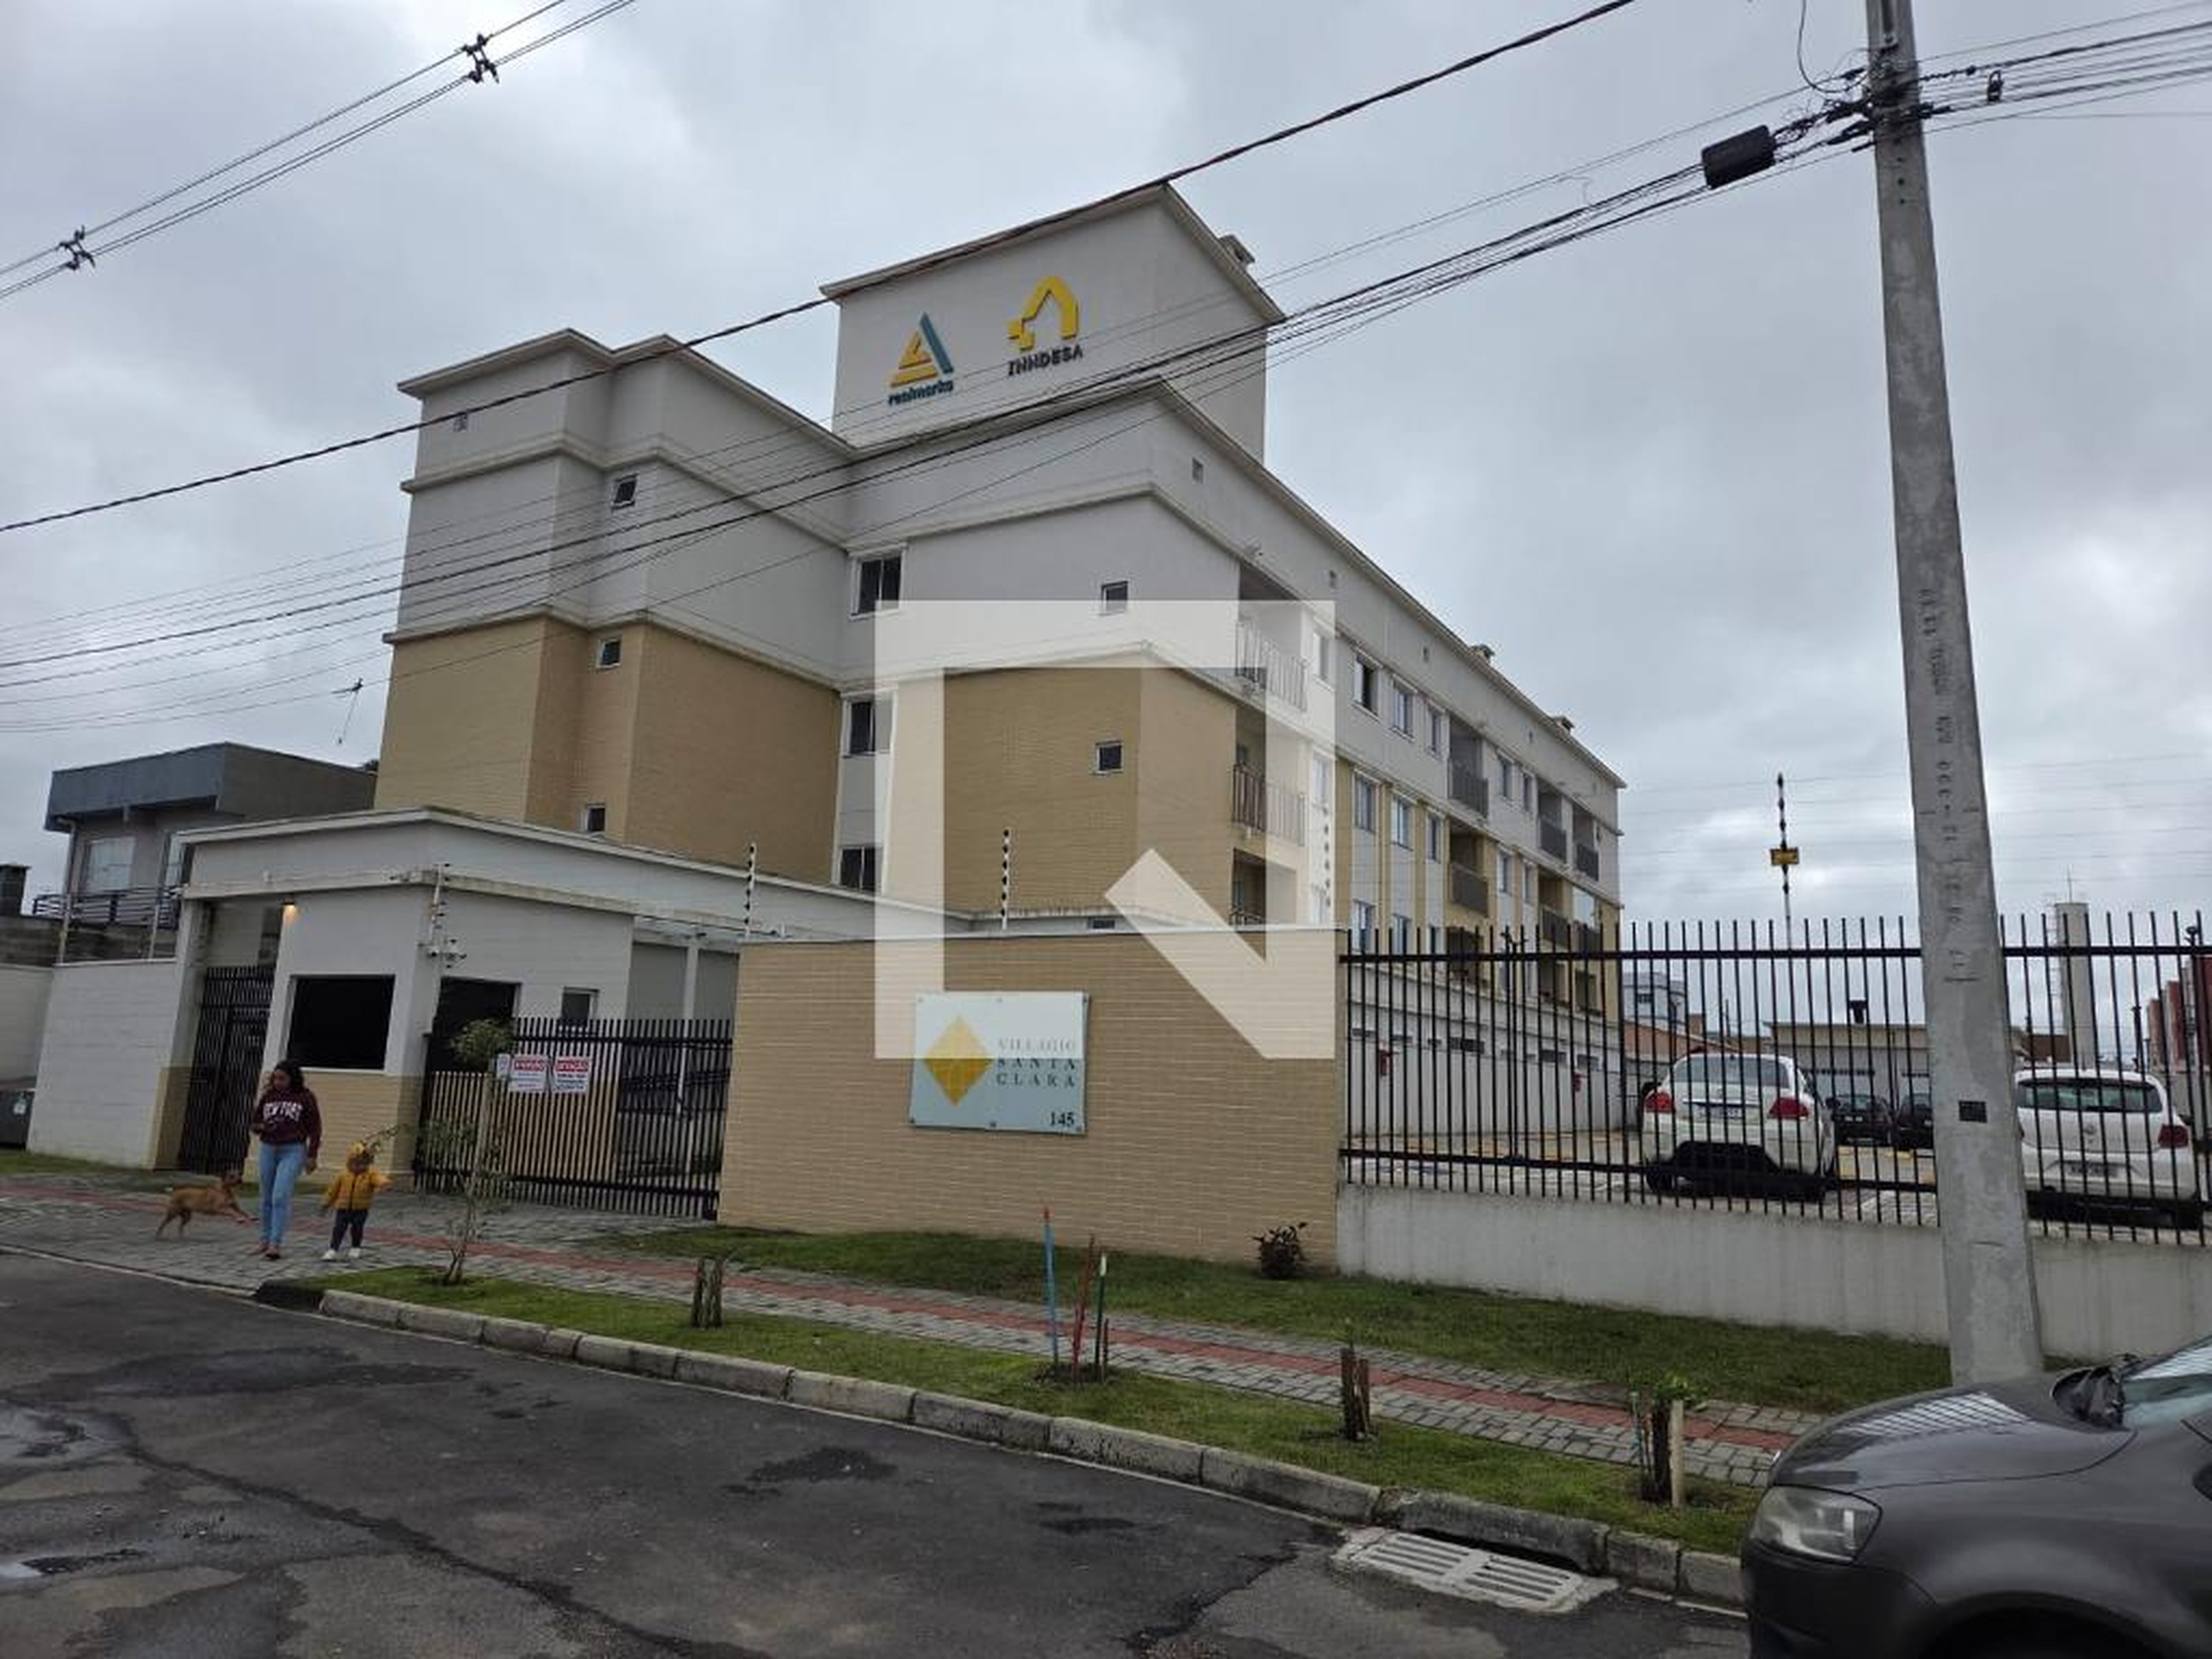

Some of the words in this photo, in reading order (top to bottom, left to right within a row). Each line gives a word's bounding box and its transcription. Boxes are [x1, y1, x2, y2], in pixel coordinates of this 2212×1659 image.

[997, 1057, 1076, 1070] SANTA
[996, 1073, 1076, 1088] CLARA
[1050, 1111, 1075, 1127] 145
